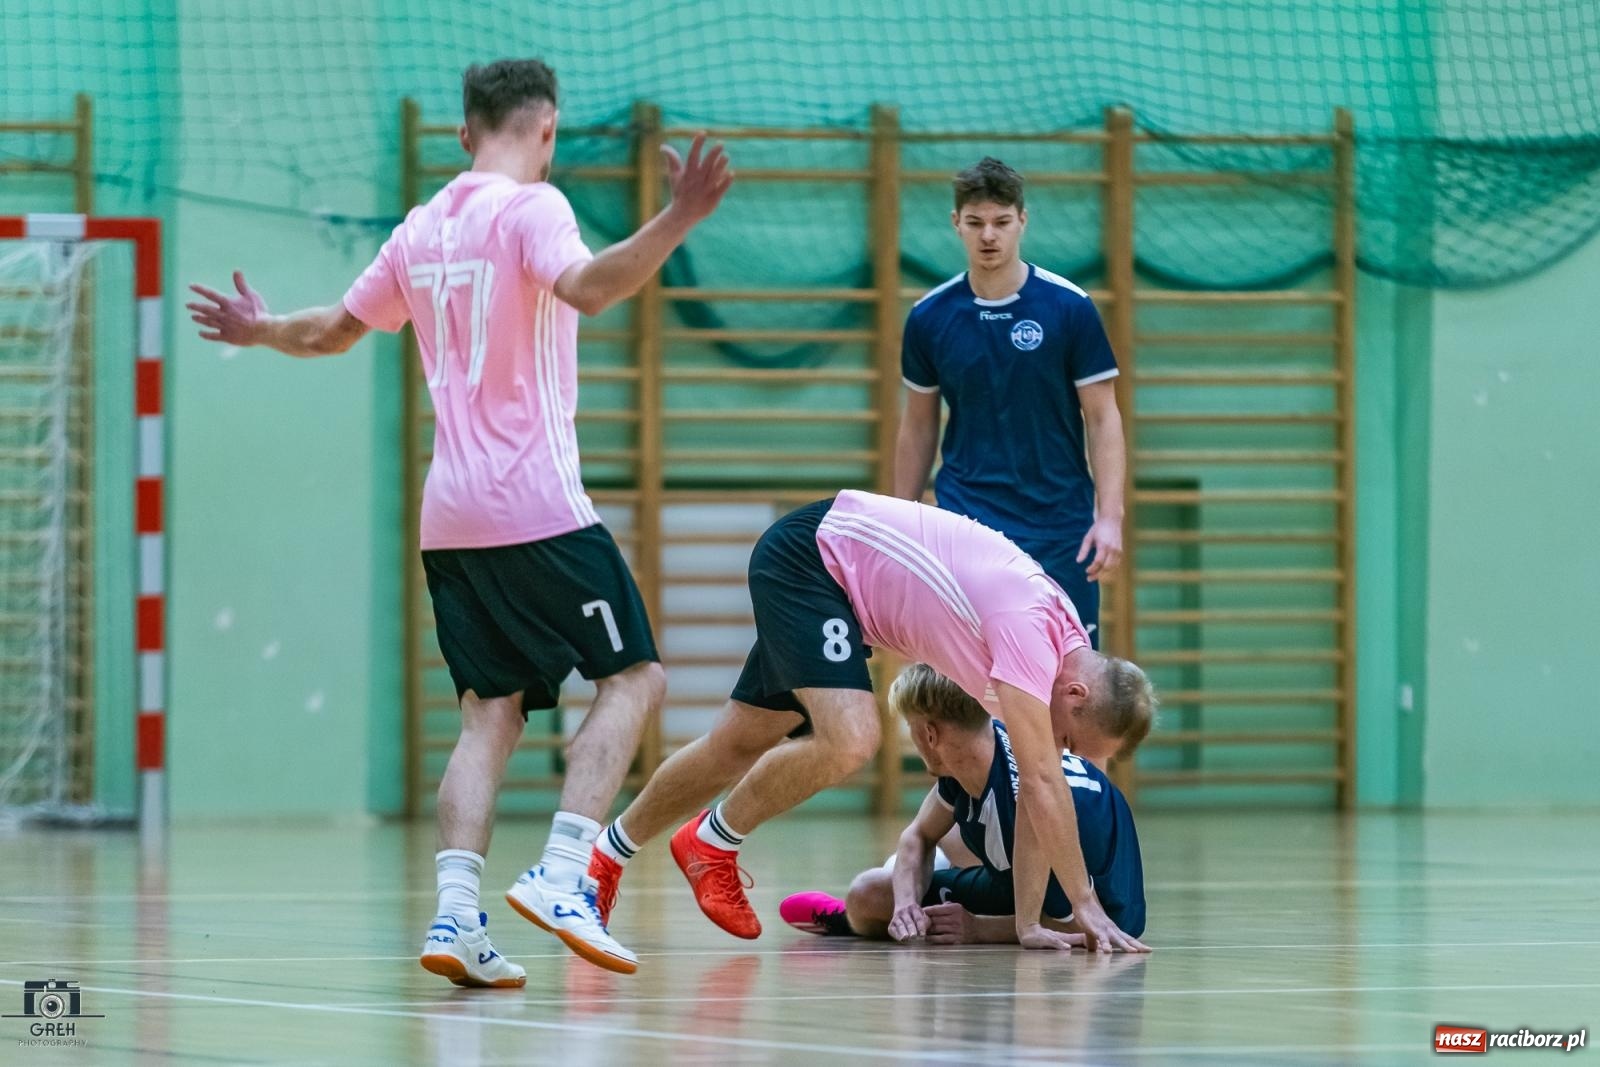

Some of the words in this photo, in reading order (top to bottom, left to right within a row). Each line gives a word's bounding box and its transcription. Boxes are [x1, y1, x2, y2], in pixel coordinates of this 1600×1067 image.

[409, 258, 495, 389] 77
[582, 600, 624, 653] 7
[822, 618, 851, 662] 8
